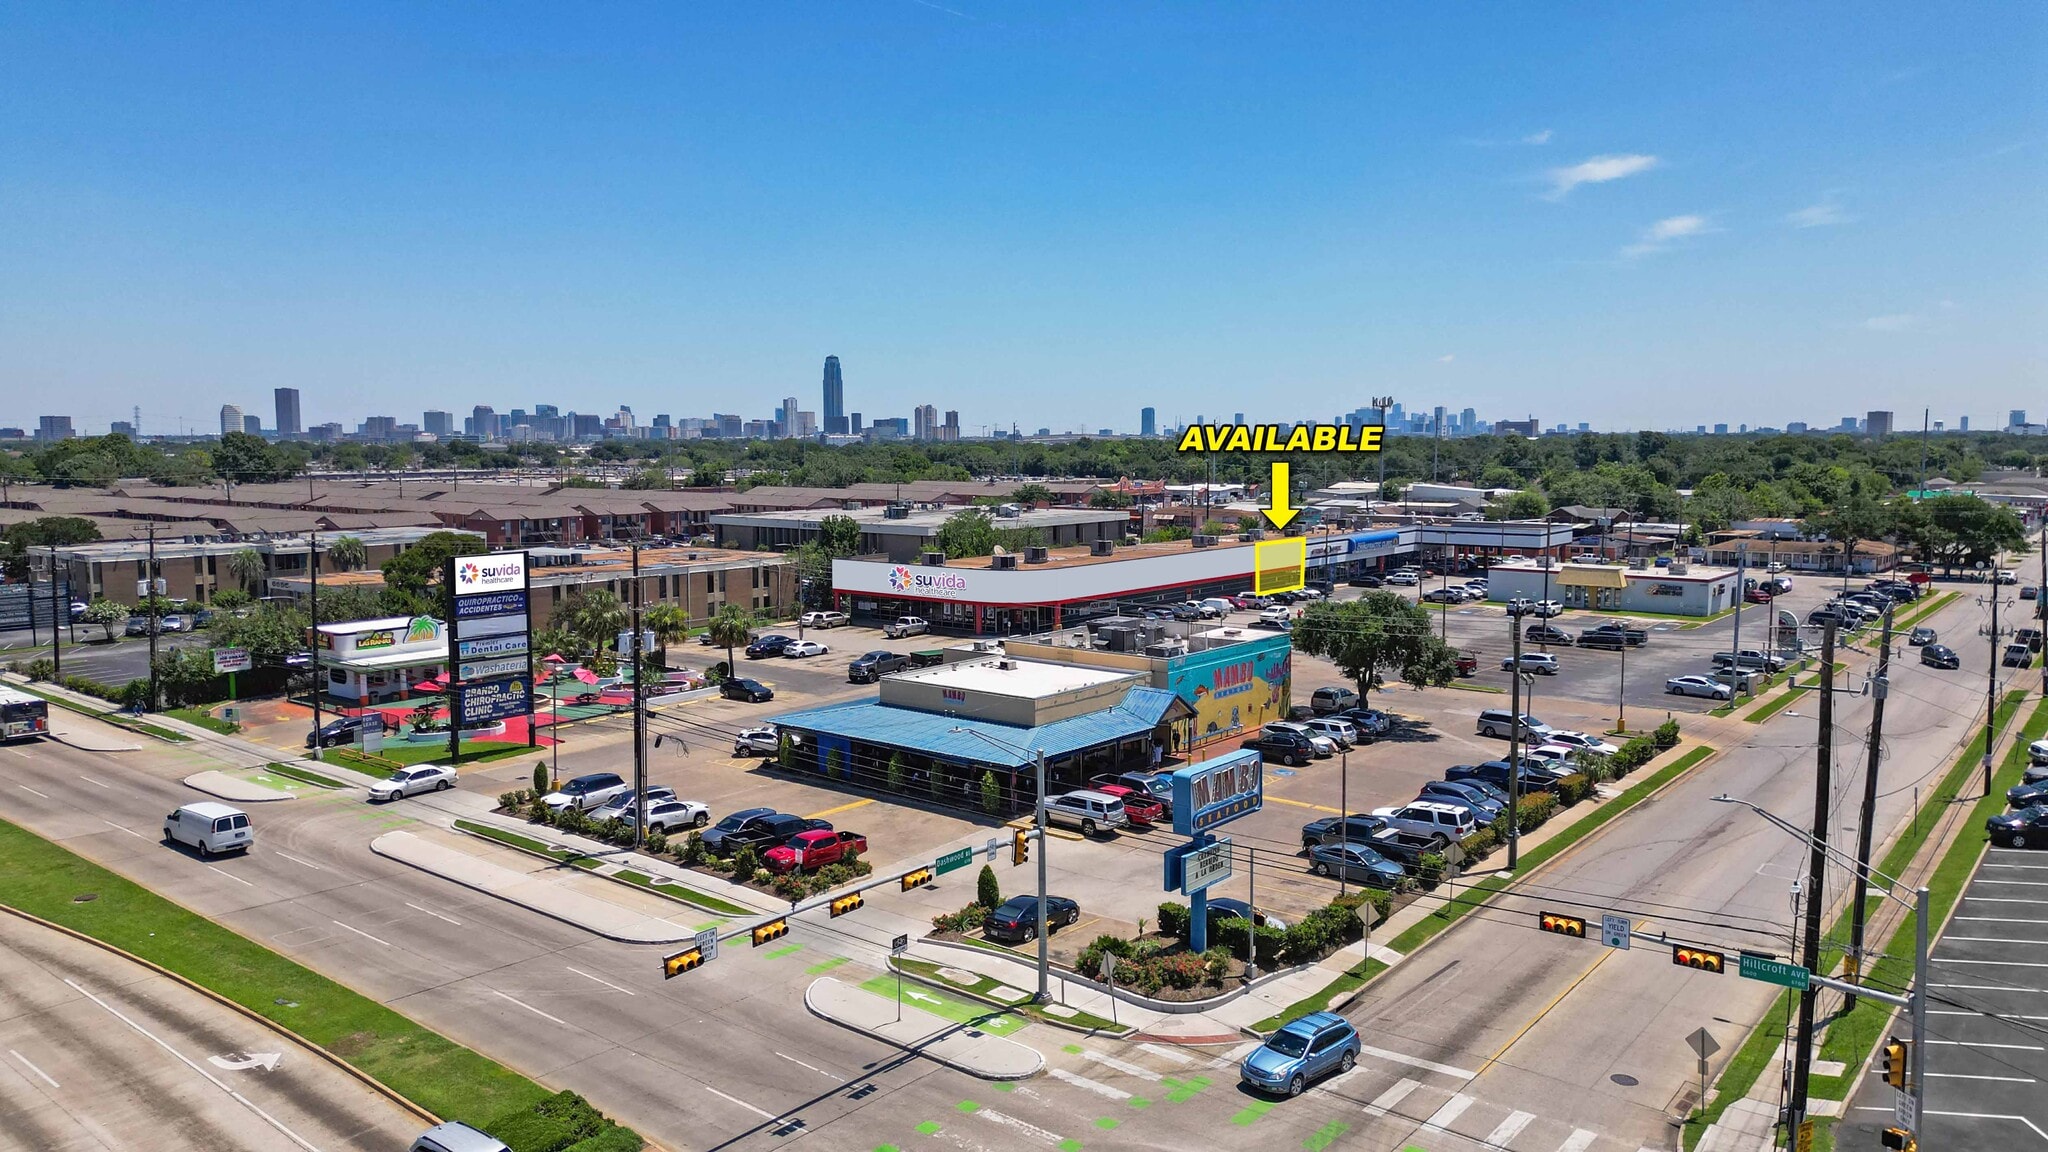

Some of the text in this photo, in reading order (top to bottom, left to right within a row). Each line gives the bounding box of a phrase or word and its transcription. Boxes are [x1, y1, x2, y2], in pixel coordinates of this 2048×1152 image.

[482, 563, 520, 578] suvida
[915, 573, 966, 588] suvida
[915, 587, 956, 596] healthcare
[458, 594, 519, 606] QUIROPRACTICO
[459, 604, 502, 614] ACCIDENTES
[472, 644, 502, 654] Dental
[476, 661, 526, 674] Washateria
[1214, 660, 1254, 690] MAMBO
[465, 684, 500, 698] BRANDO
[464, 690, 525, 707] CHIROPRACTIC
[464, 704, 493, 716] CLINIC
[1192, 760, 1259, 811] MAMBO
[1199, 797, 1258, 826] SEAFOOD
[936, 851, 964, 868] Dashwood
[1200, 868, 1206, 876] LA
[1209, 861, 1224, 872] ORDEN
[1608, 923, 1624, 932] YIELD
[698, 934, 708, 942] LEFT
[1743, 958, 1806, 979] Hillcroft AVE
[1898, 1100, 1912, 1112] GREEN
